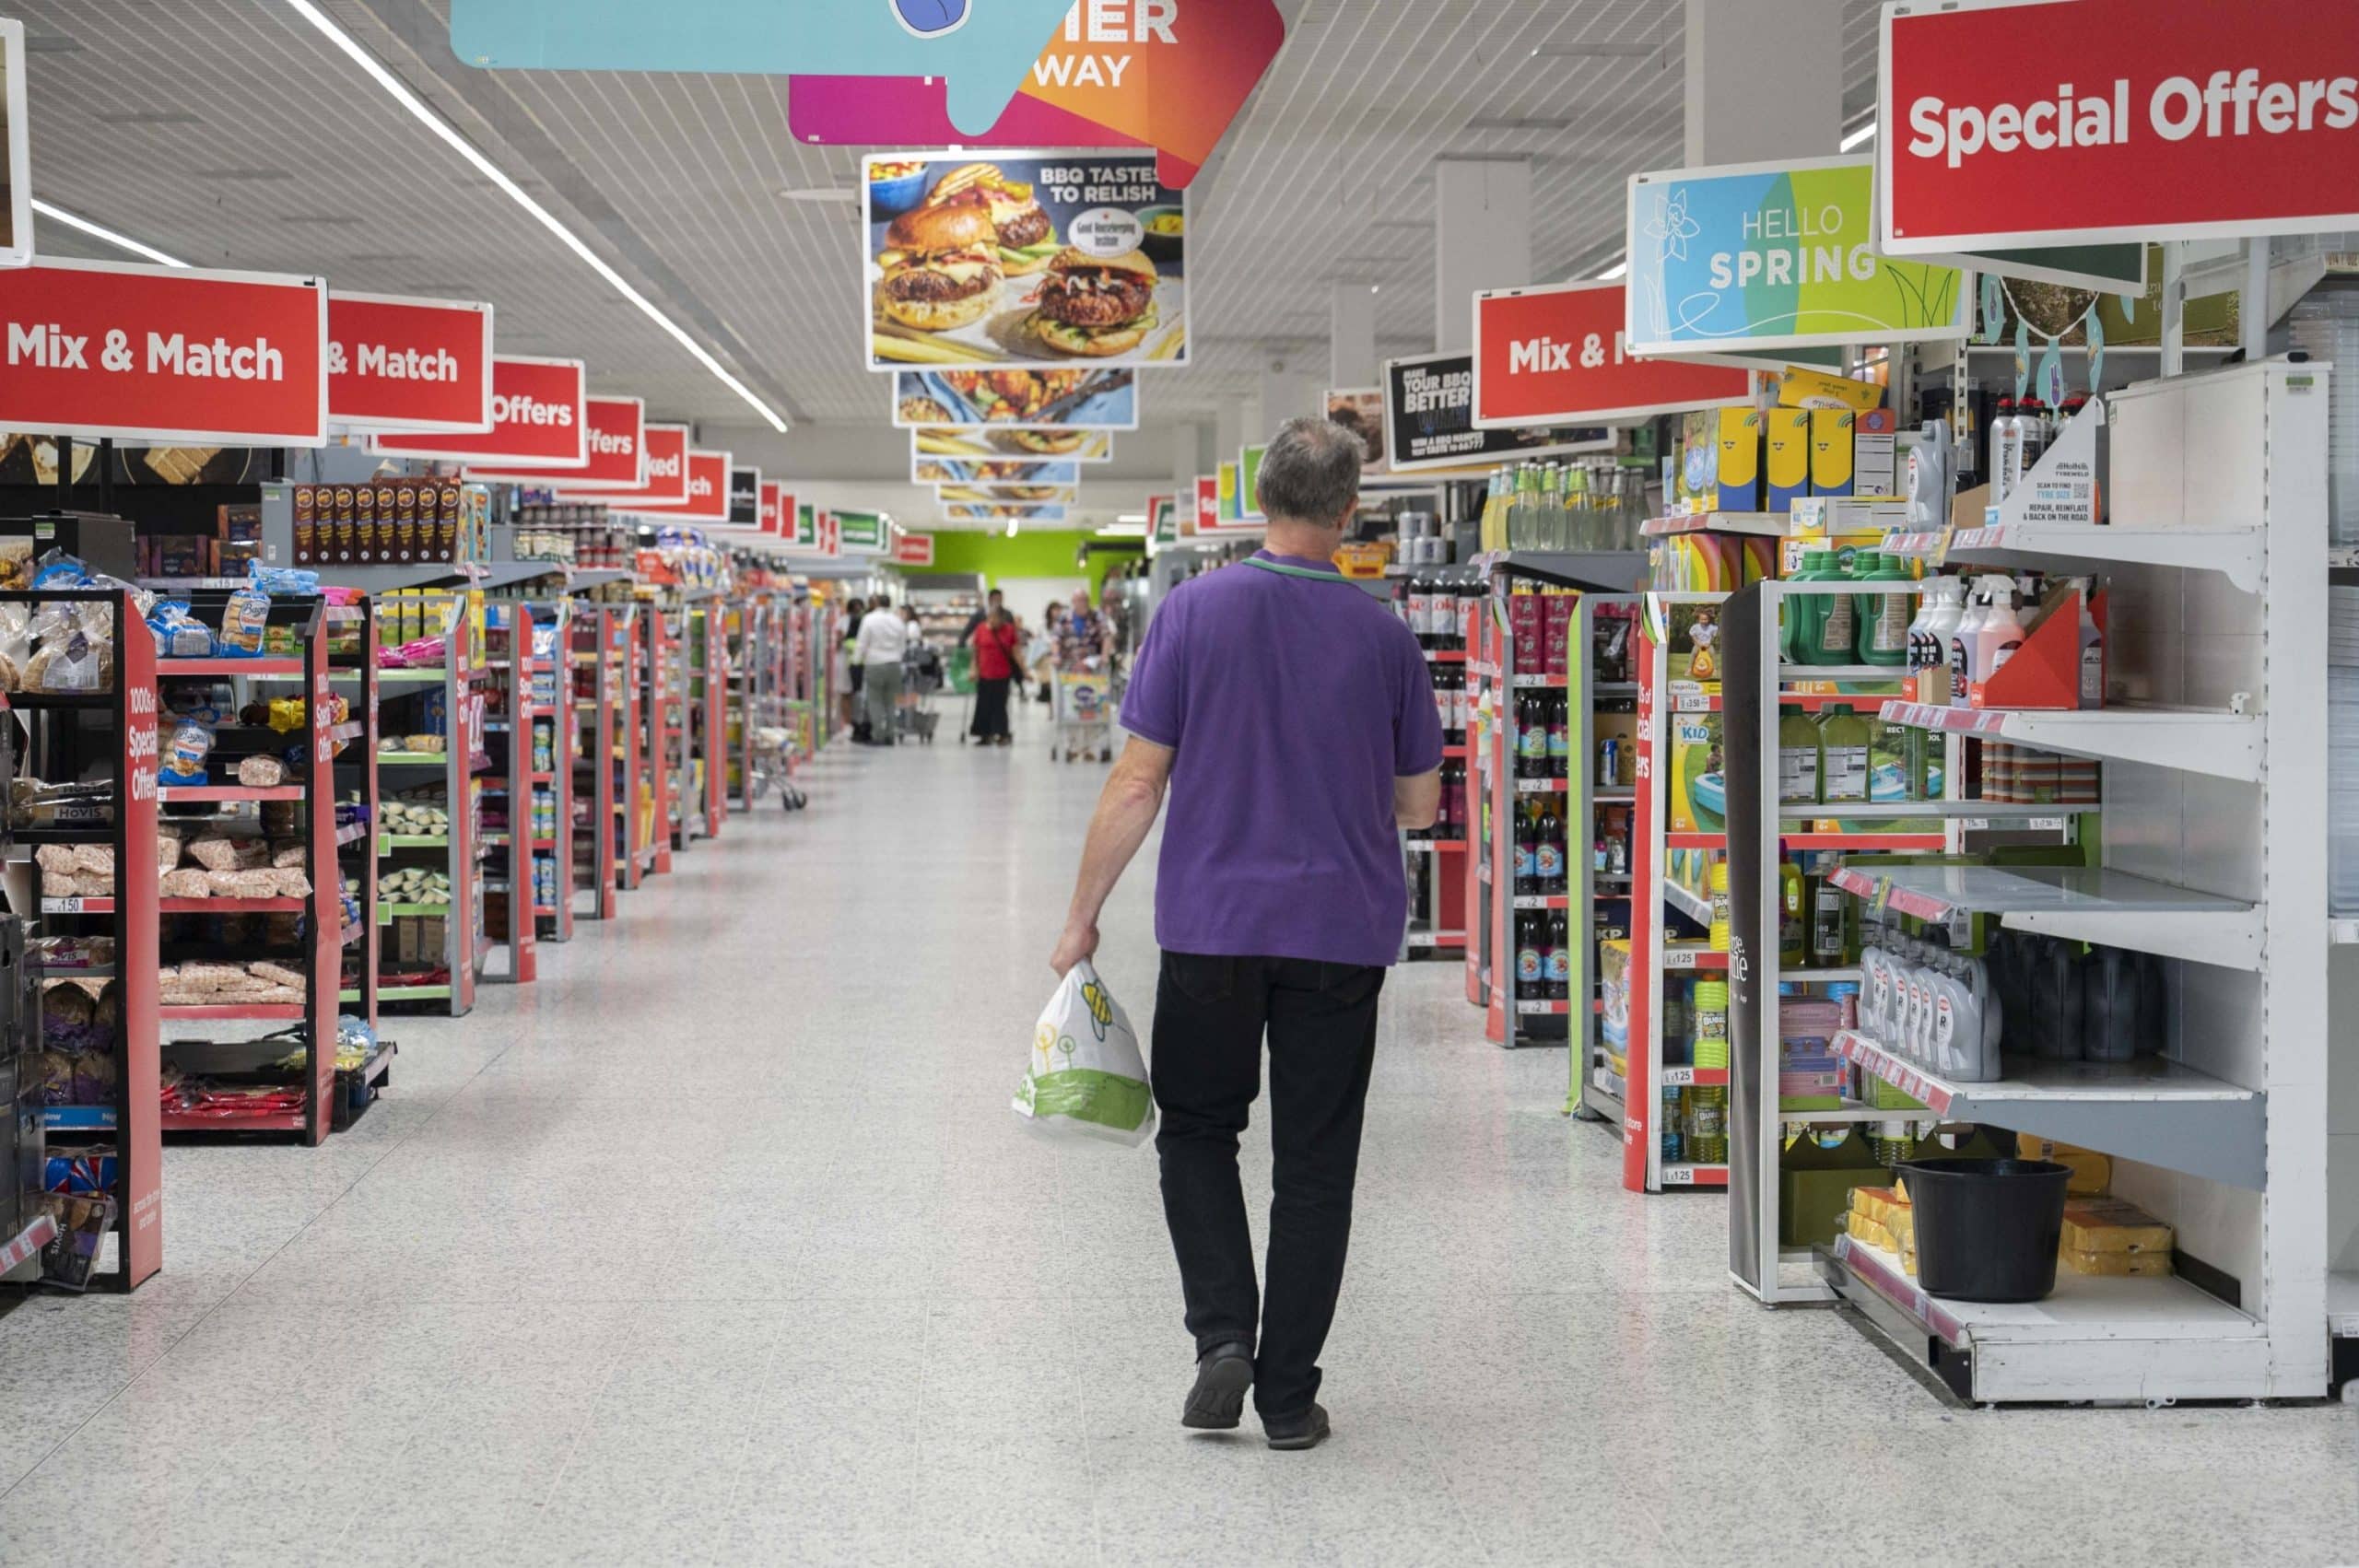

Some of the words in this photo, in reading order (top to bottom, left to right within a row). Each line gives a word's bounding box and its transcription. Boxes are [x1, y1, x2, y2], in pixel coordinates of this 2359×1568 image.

[1033, 54, 1132, 87] WAY
[1908, 79, 2129, 169] Special
[2150, 68, 2358, 141] Offers
[1040, 168, 1084, 184] BBQ
[1050, 187, 1079, 203] TO
[1084, 186, 1156, 203] RELISH
[1743, 205, 1843, 240] HELLO
[1709, 243, 1876, 289] SPRING
[7, 322, 88, 369] Mix
[101, 329, 134, 372] &
[147, 332, 283, 381] Match
[328, 341, 347, 374] &
[358, 344, 457, 382] Match
[1509, 336, 1572, 375] Mix
[1580, 333, 1605, 369] &
[1403, 376, 1440, 393] YOUR
[493, 395, 572, 426] Offers
[1404, 387, 1470, 414] BETTER
[2029, 504, 2054, 513] REPAIR,
[2056, 504, 2088, 512] REINFLATE
[2029, 513, 2046, 521] BACK
[2048, 513, 2057, 521] ON
[2058, 513, 2070, 521] THE
[2071, 513, 2089, 521] ROAD
[1682, 726, 1708, 739] KID
[1595, 928, 1623, 940] KP
